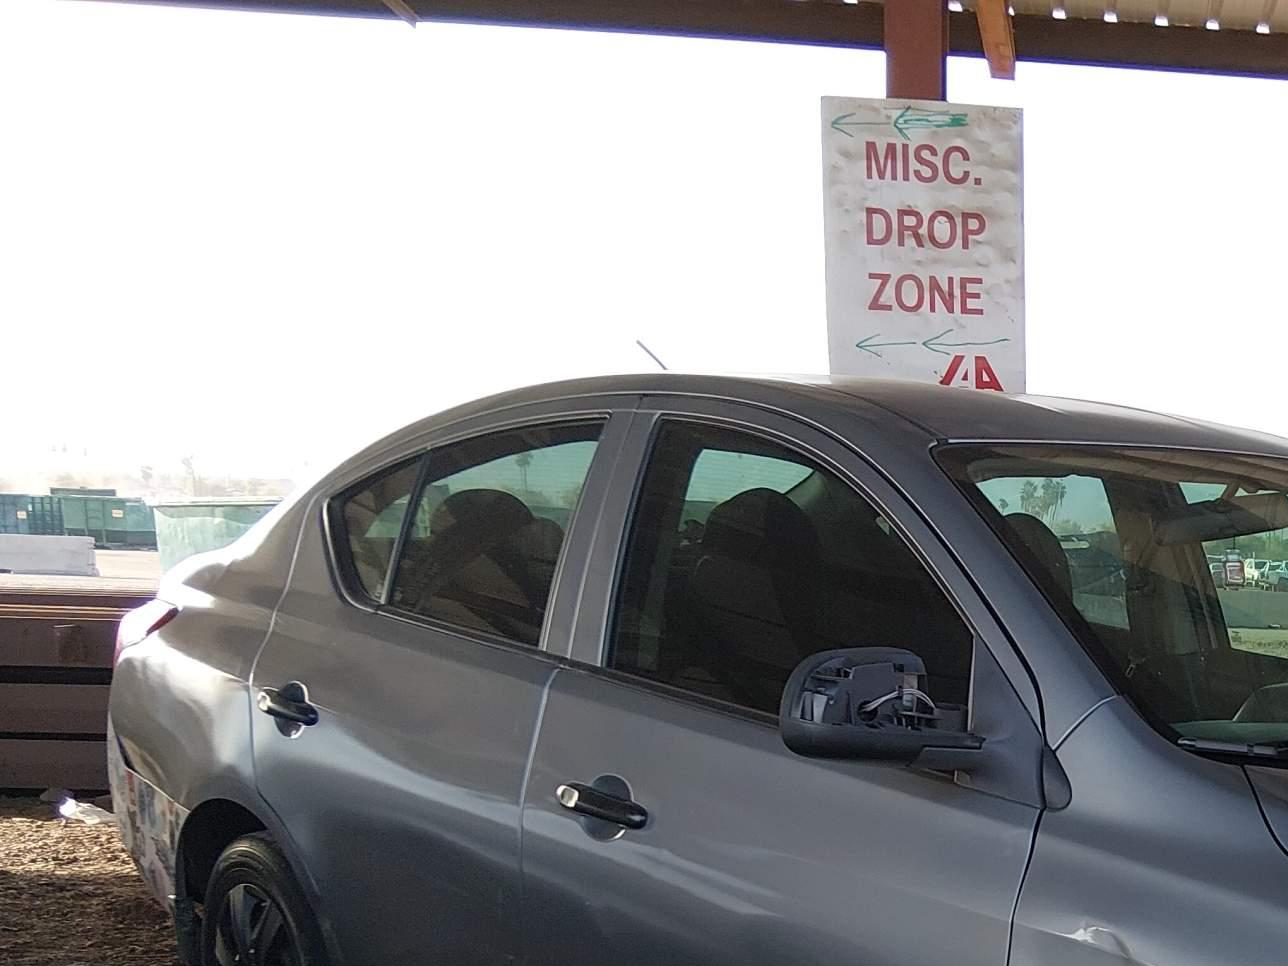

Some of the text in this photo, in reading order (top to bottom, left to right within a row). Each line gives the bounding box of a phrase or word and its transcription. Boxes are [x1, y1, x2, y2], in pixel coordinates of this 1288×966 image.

[864, 141, 982, 186] MISC.
[865, 206, 987, 250] DROP
[867, 272, 985, 316] ZONE
